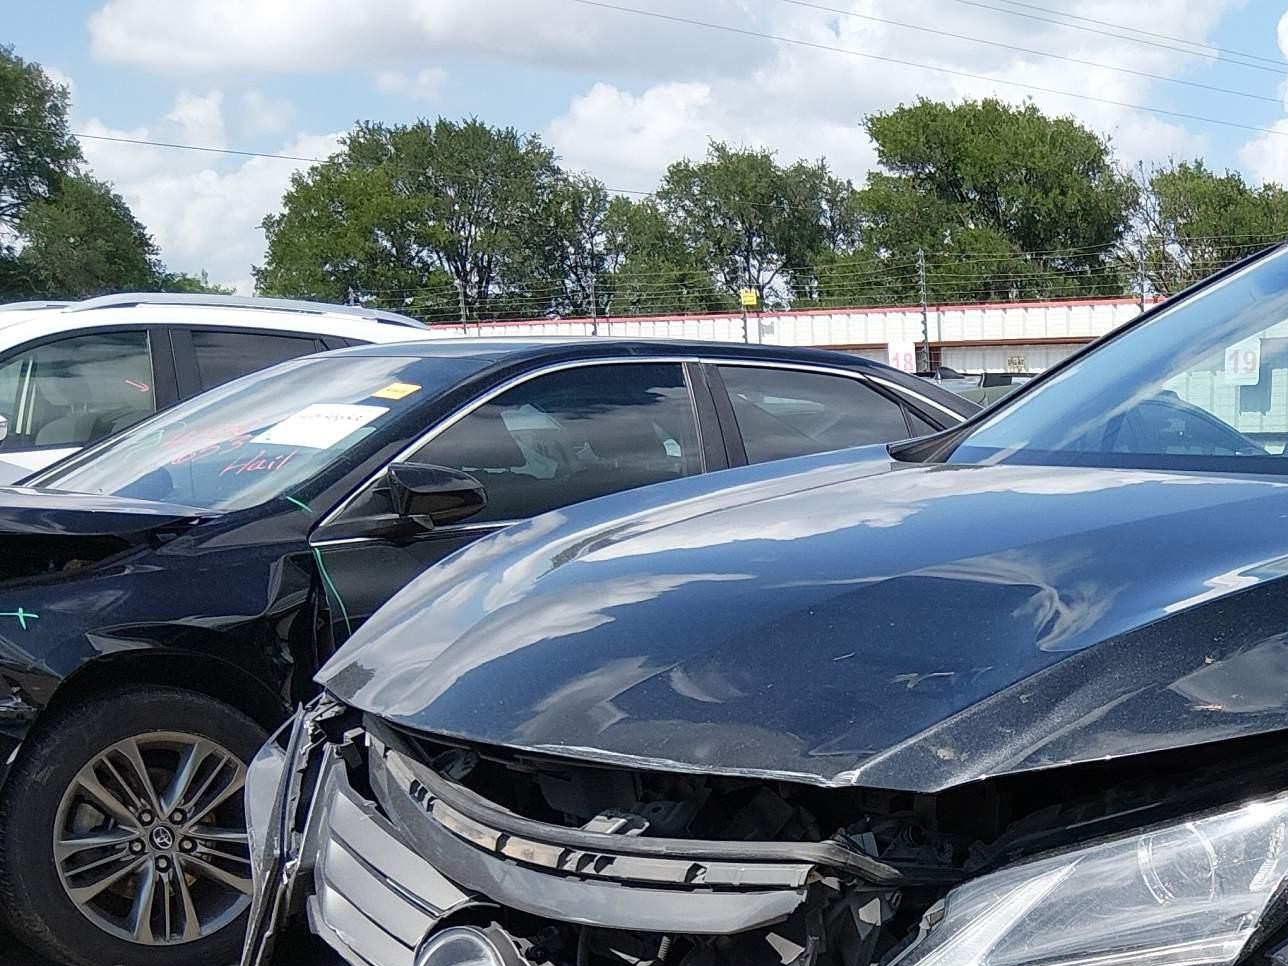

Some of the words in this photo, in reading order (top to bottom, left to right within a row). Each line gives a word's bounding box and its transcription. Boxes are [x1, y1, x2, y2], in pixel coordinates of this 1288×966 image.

[892, 352, 914, 374] 18
[1229, 350, 1257, 374] 19
[218, 449, 298, 477] Hail
